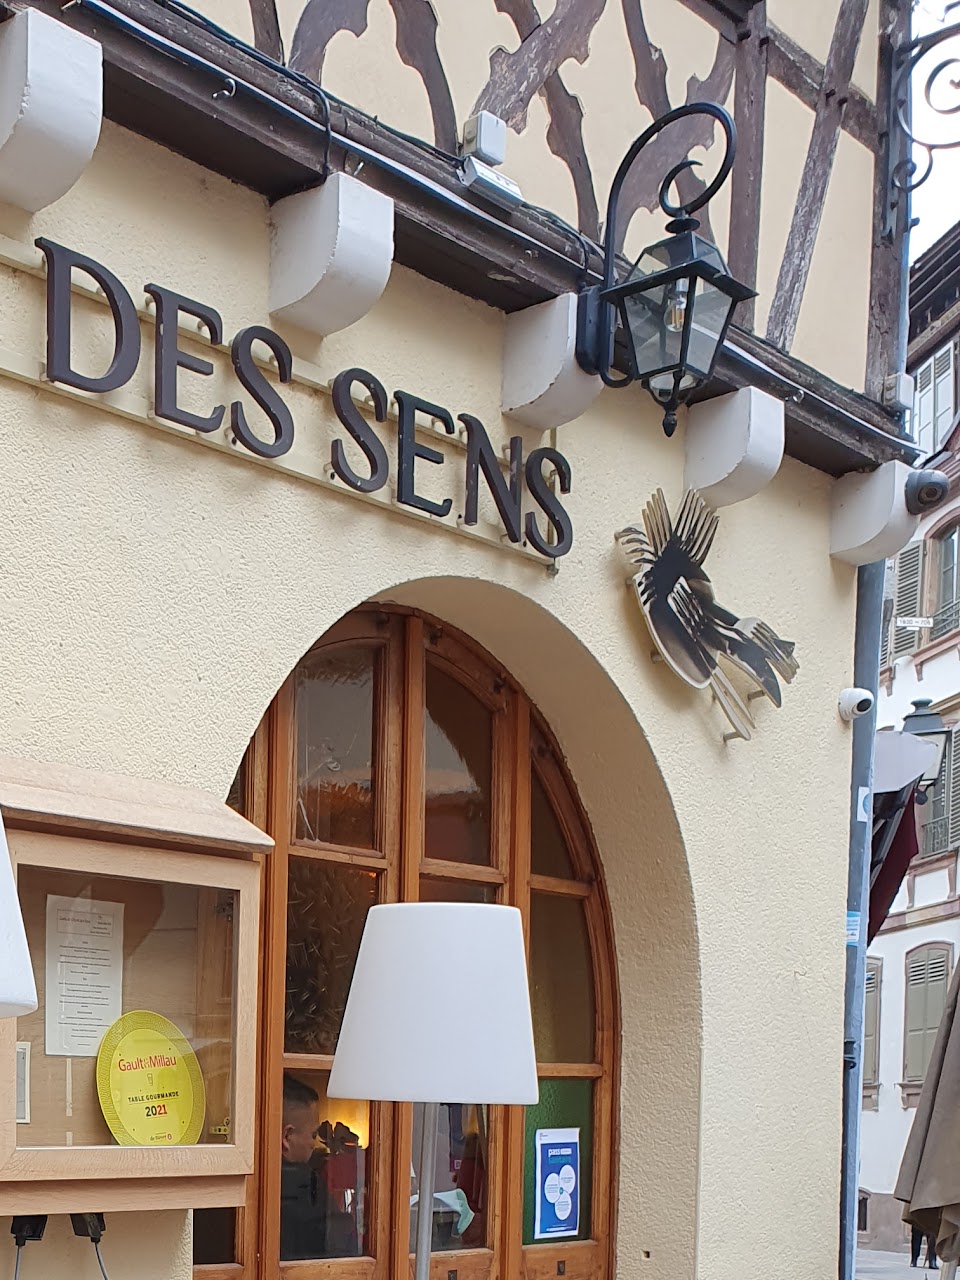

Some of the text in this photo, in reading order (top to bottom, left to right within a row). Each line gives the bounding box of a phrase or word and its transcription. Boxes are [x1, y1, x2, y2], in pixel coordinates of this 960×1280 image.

[34, 236, 295, 458] DES
[330, 367, 574, 559] SENS
[128, 1091, 179, 1103] TABLE GOURMANDE
[145, 1104, 167, 1117] 2021
